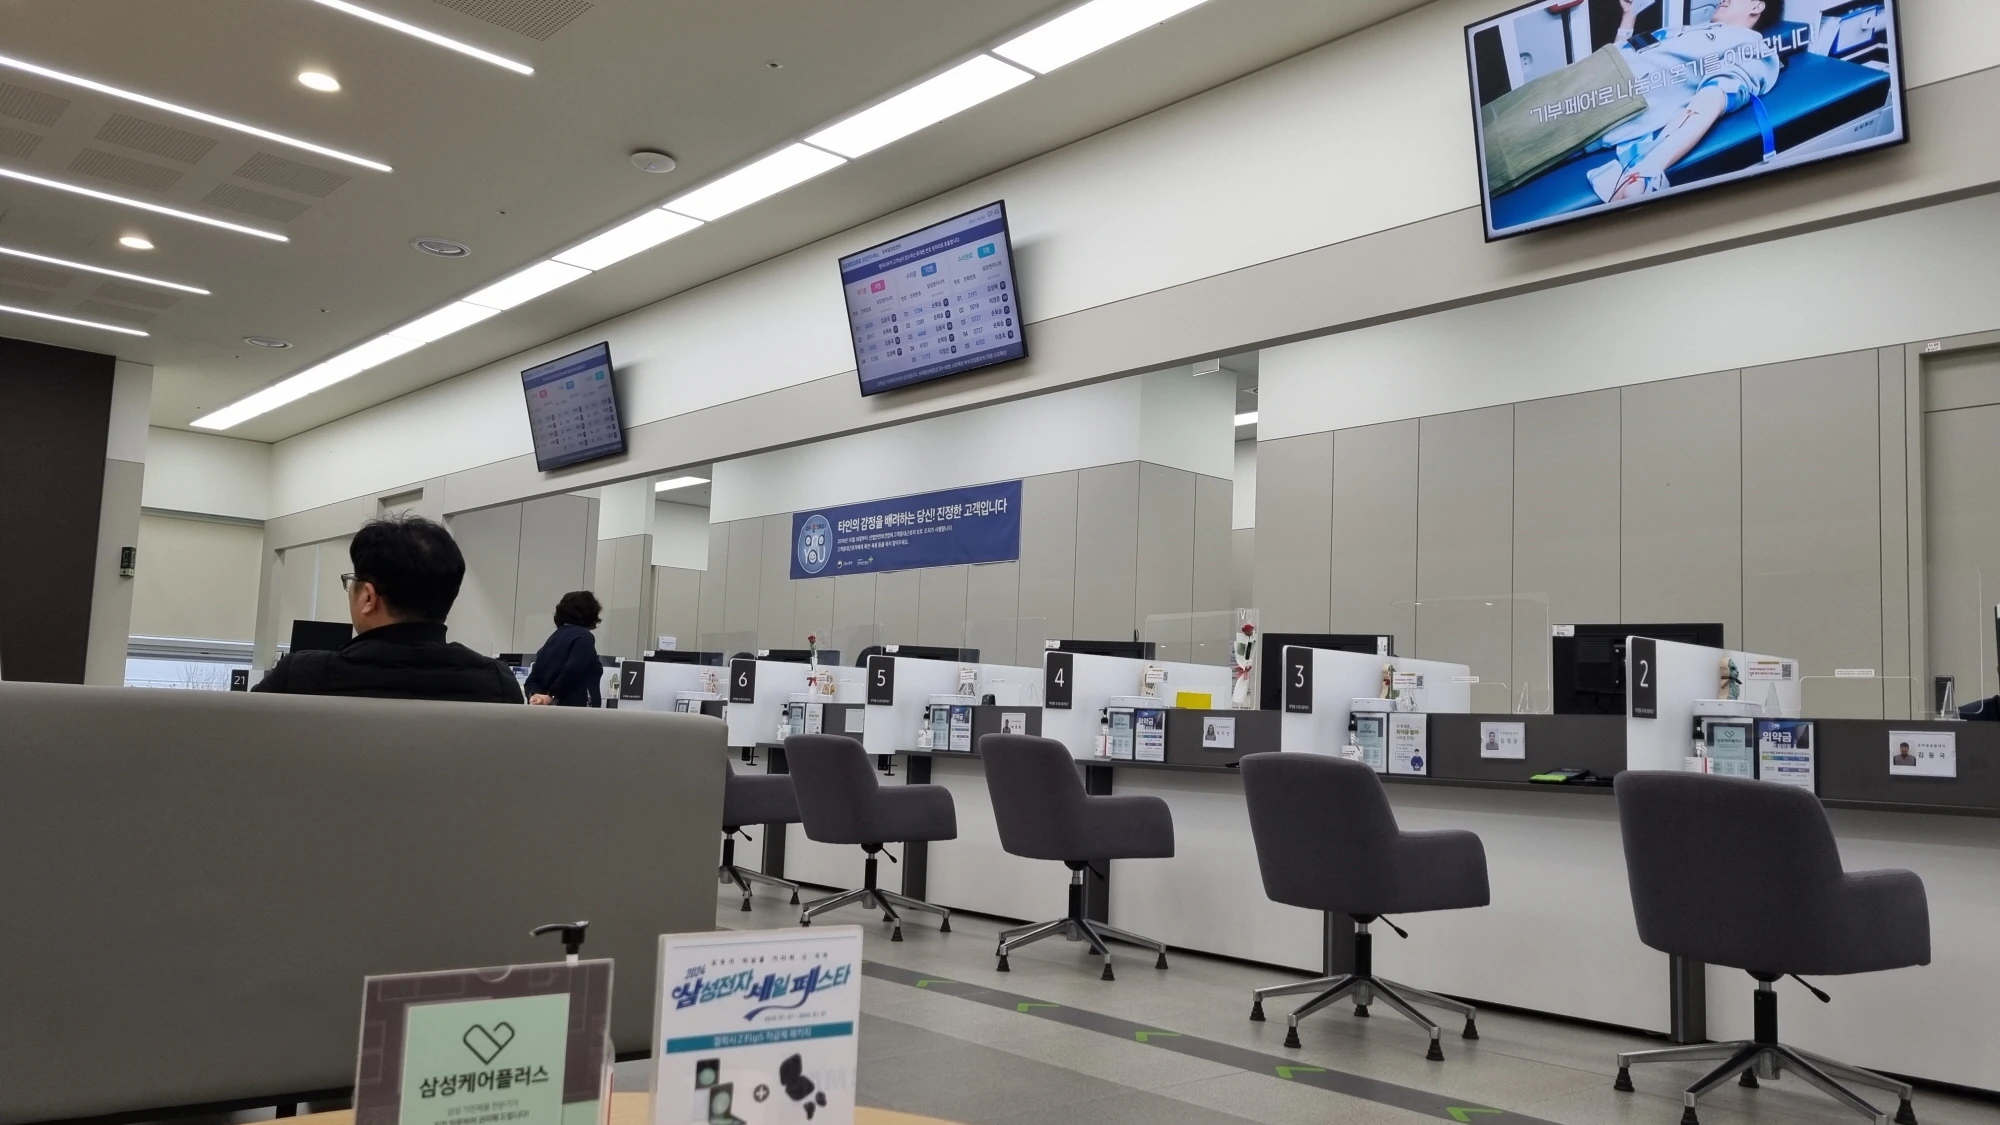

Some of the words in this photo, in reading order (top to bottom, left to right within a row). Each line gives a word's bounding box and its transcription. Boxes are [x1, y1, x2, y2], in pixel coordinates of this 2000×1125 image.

[1617, 72, 1667, 100] 나눔의
[1669, 53, 1721, 84] 온기를
[1724, 23, 1816, 66] 이어갑니다
[838, 519, 859, 533] 타인의
[861, 516, 883, 530] 감정을
[885, 511, 915, 527] 배려하는
[917, 507, 935, 522] 당신!
[937, 504, 962, 518] 진정한
[964, 498, 1007, 516] 고객입니다
[234, 676, 245, 685] 21
[629, 671, 638, 686] 7
[738, 672, 748, 687] 6
[877, 669, 886, 688] 5
[1054, 668, 1064, 688] 4
[1295, 664, 1304, 688] 3
[1640, 660, 1649, 688] 2
[1762, 731, 1792, 743] 위약금
[672, 969, 754, 1010] 삼성전자
[744, 973, 791, 1002] 세일
[790, 963, 851, 993] 페스타
[419, 1064, 550, 1098] 삼성케어플러스
